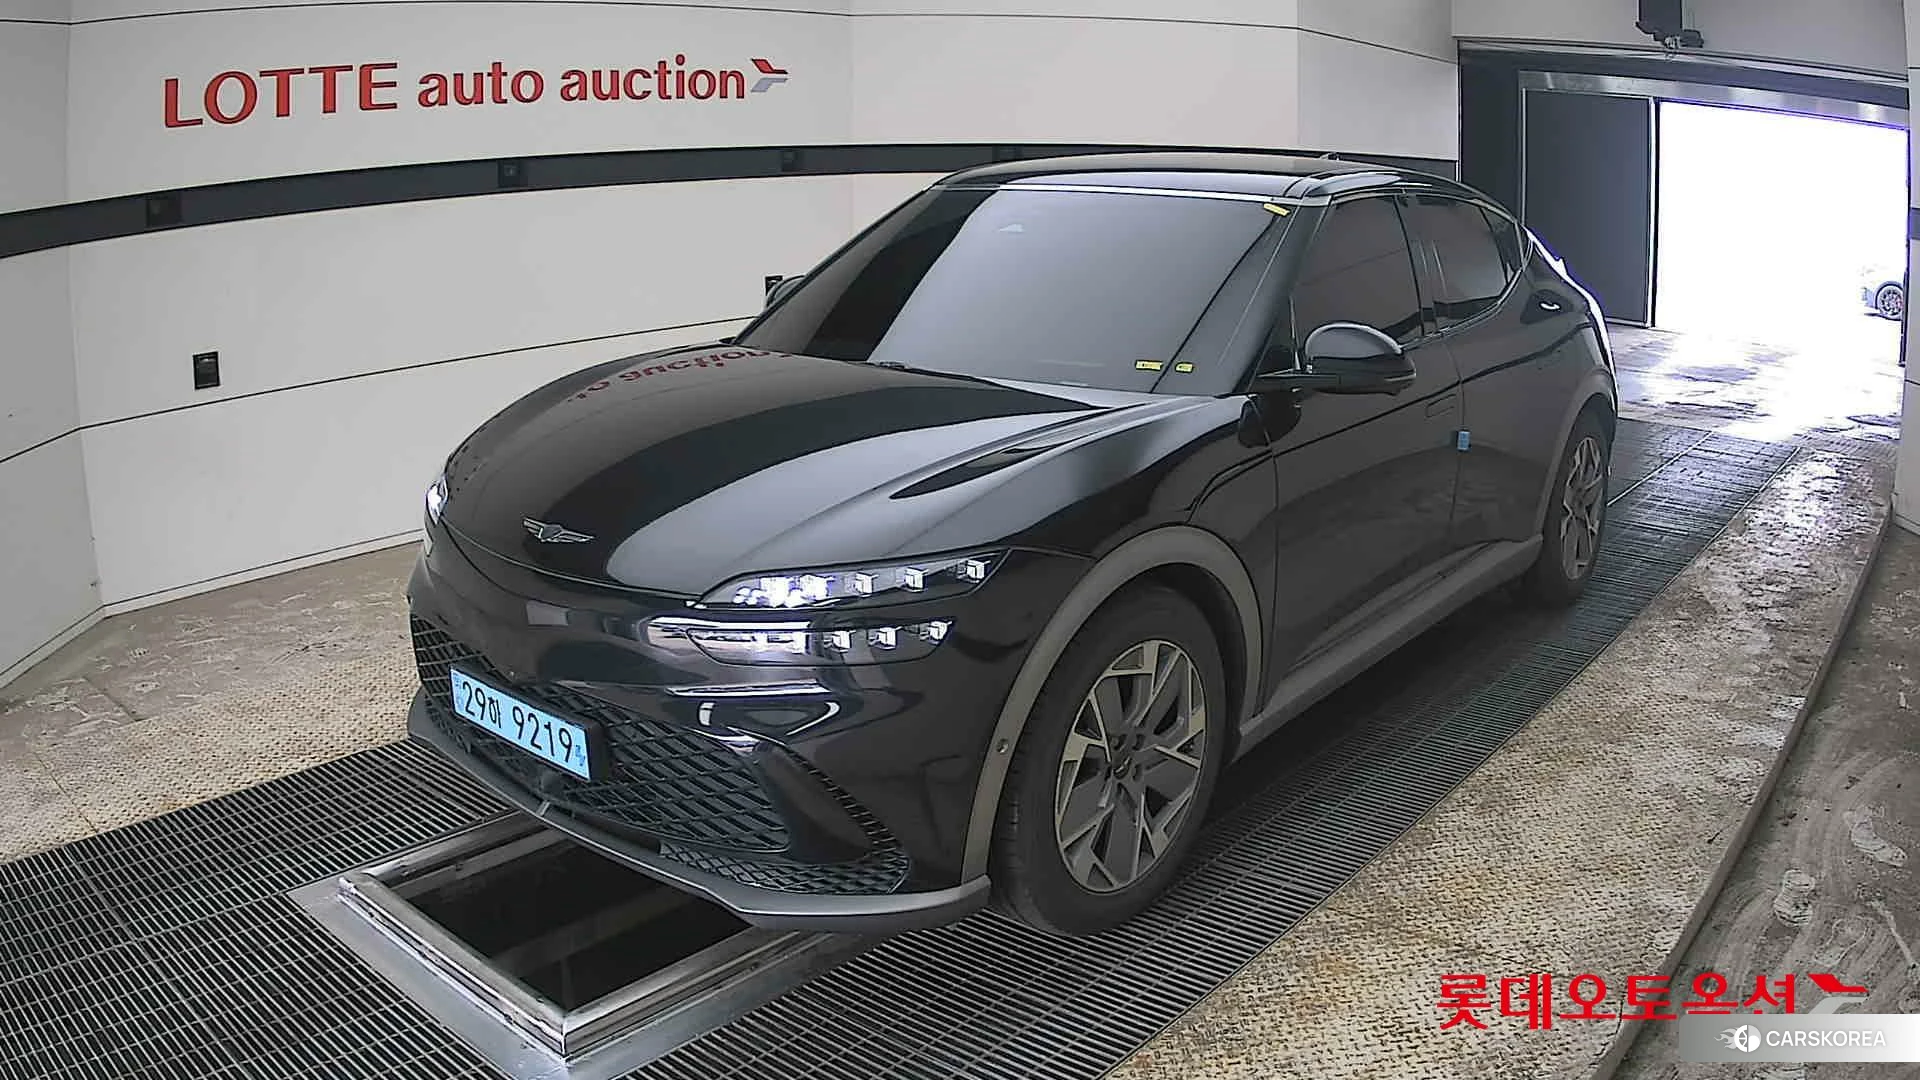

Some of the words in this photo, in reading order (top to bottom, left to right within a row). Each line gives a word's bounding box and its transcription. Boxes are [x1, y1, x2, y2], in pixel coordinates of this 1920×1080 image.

[164, 62, 398, 128] LOTTE
[417, 61, 545, 107] auto
[560, 54, 746, 101] auction
[512, 706, 573, 763] 9219
